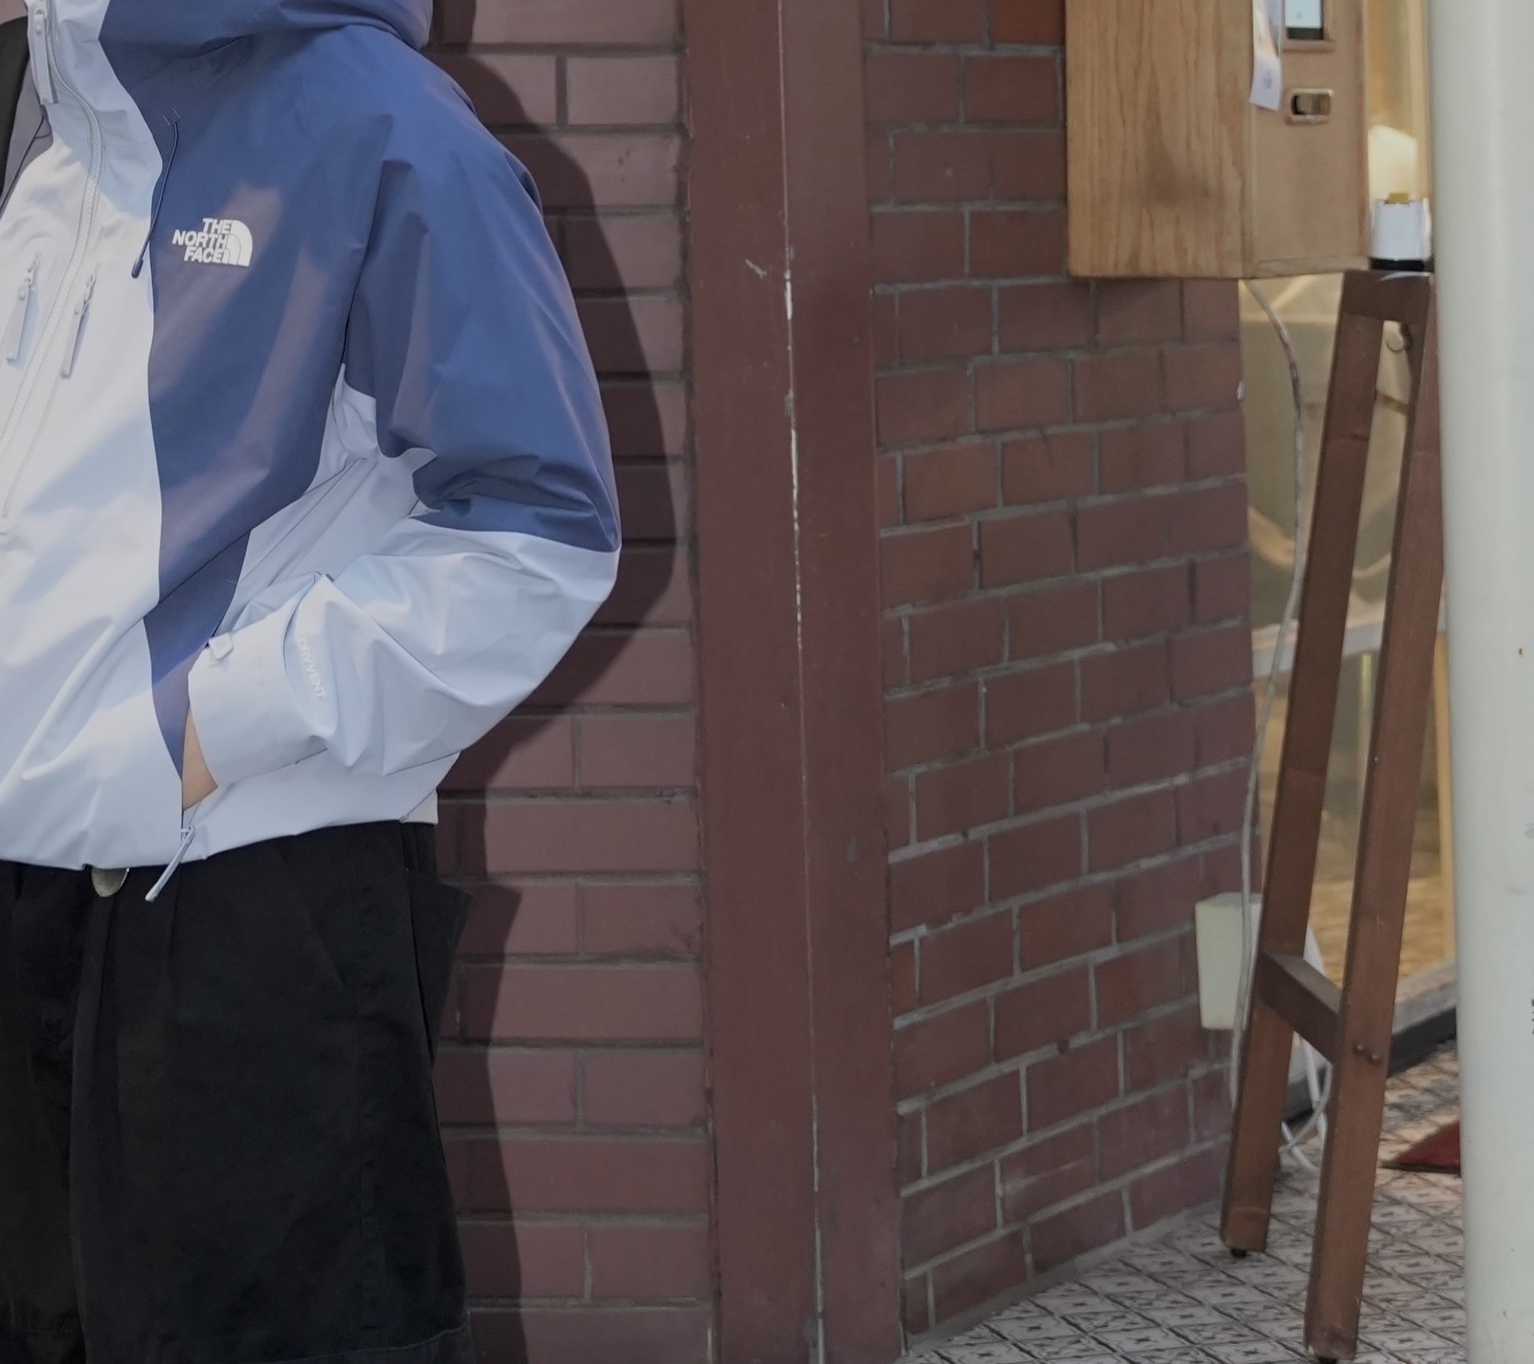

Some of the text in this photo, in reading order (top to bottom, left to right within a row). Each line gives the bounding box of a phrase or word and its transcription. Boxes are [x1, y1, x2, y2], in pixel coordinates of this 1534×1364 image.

[202, 217, 232, 234] THE
[172, 229, 228, 249] NORTH
[183, 246, 224, 264] FACE
